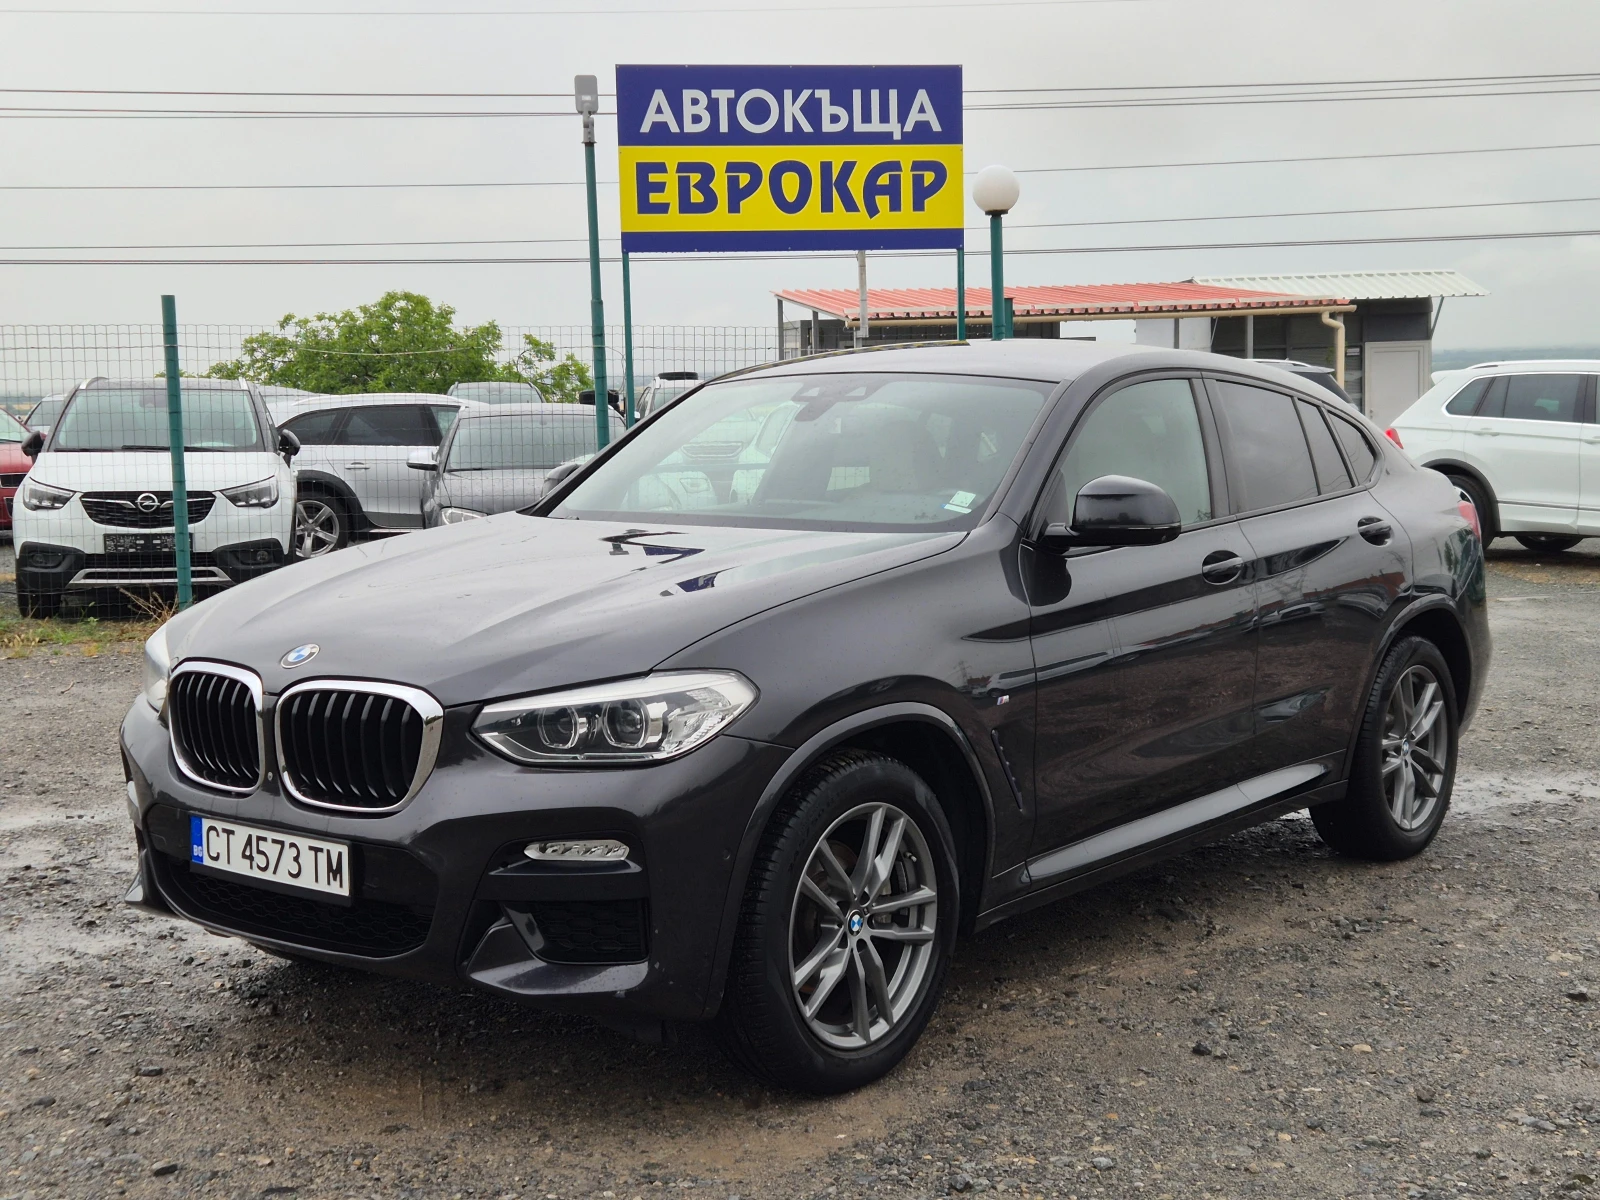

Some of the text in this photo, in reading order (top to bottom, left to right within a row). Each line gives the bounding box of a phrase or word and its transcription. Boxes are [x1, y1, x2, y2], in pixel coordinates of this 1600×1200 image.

[639, 88, 942, 140] АВТОКЪЩА
[635, 159, 948, 220] ЕВРОКАР
[192, 844, 203, 857] BG
[206, 825, 343, 888] CT 4573 TM
